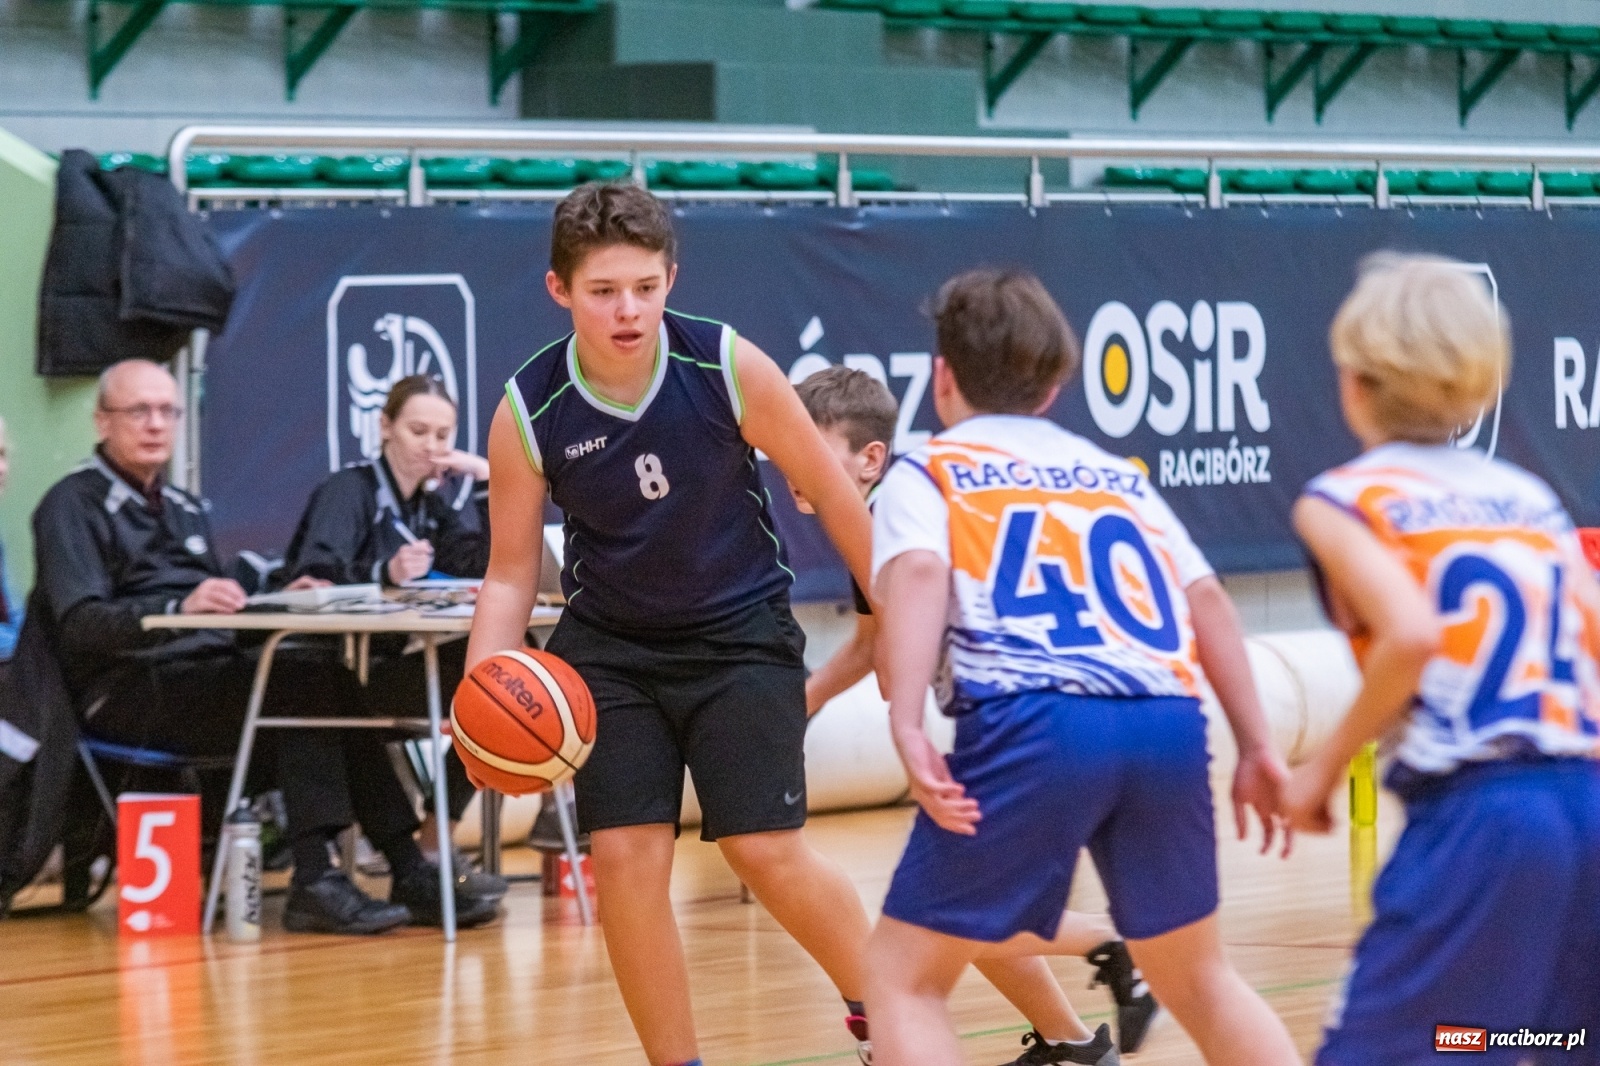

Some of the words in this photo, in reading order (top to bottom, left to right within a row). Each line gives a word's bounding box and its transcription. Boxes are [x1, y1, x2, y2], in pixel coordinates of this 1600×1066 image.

[1083, 300, 1271, 438] OSiR
[579, 436, 607, 456] HHT
[1159, 435, 1271, 487] RACIBÓRZ
[635, 453, 670, 500] 8
[949, 459, 1145, 498] RACIBÓRZ
[992, 510, 1180, 651] 40
[482, 662, 544, 721] molten
[120, 811, 176, 904] 5
